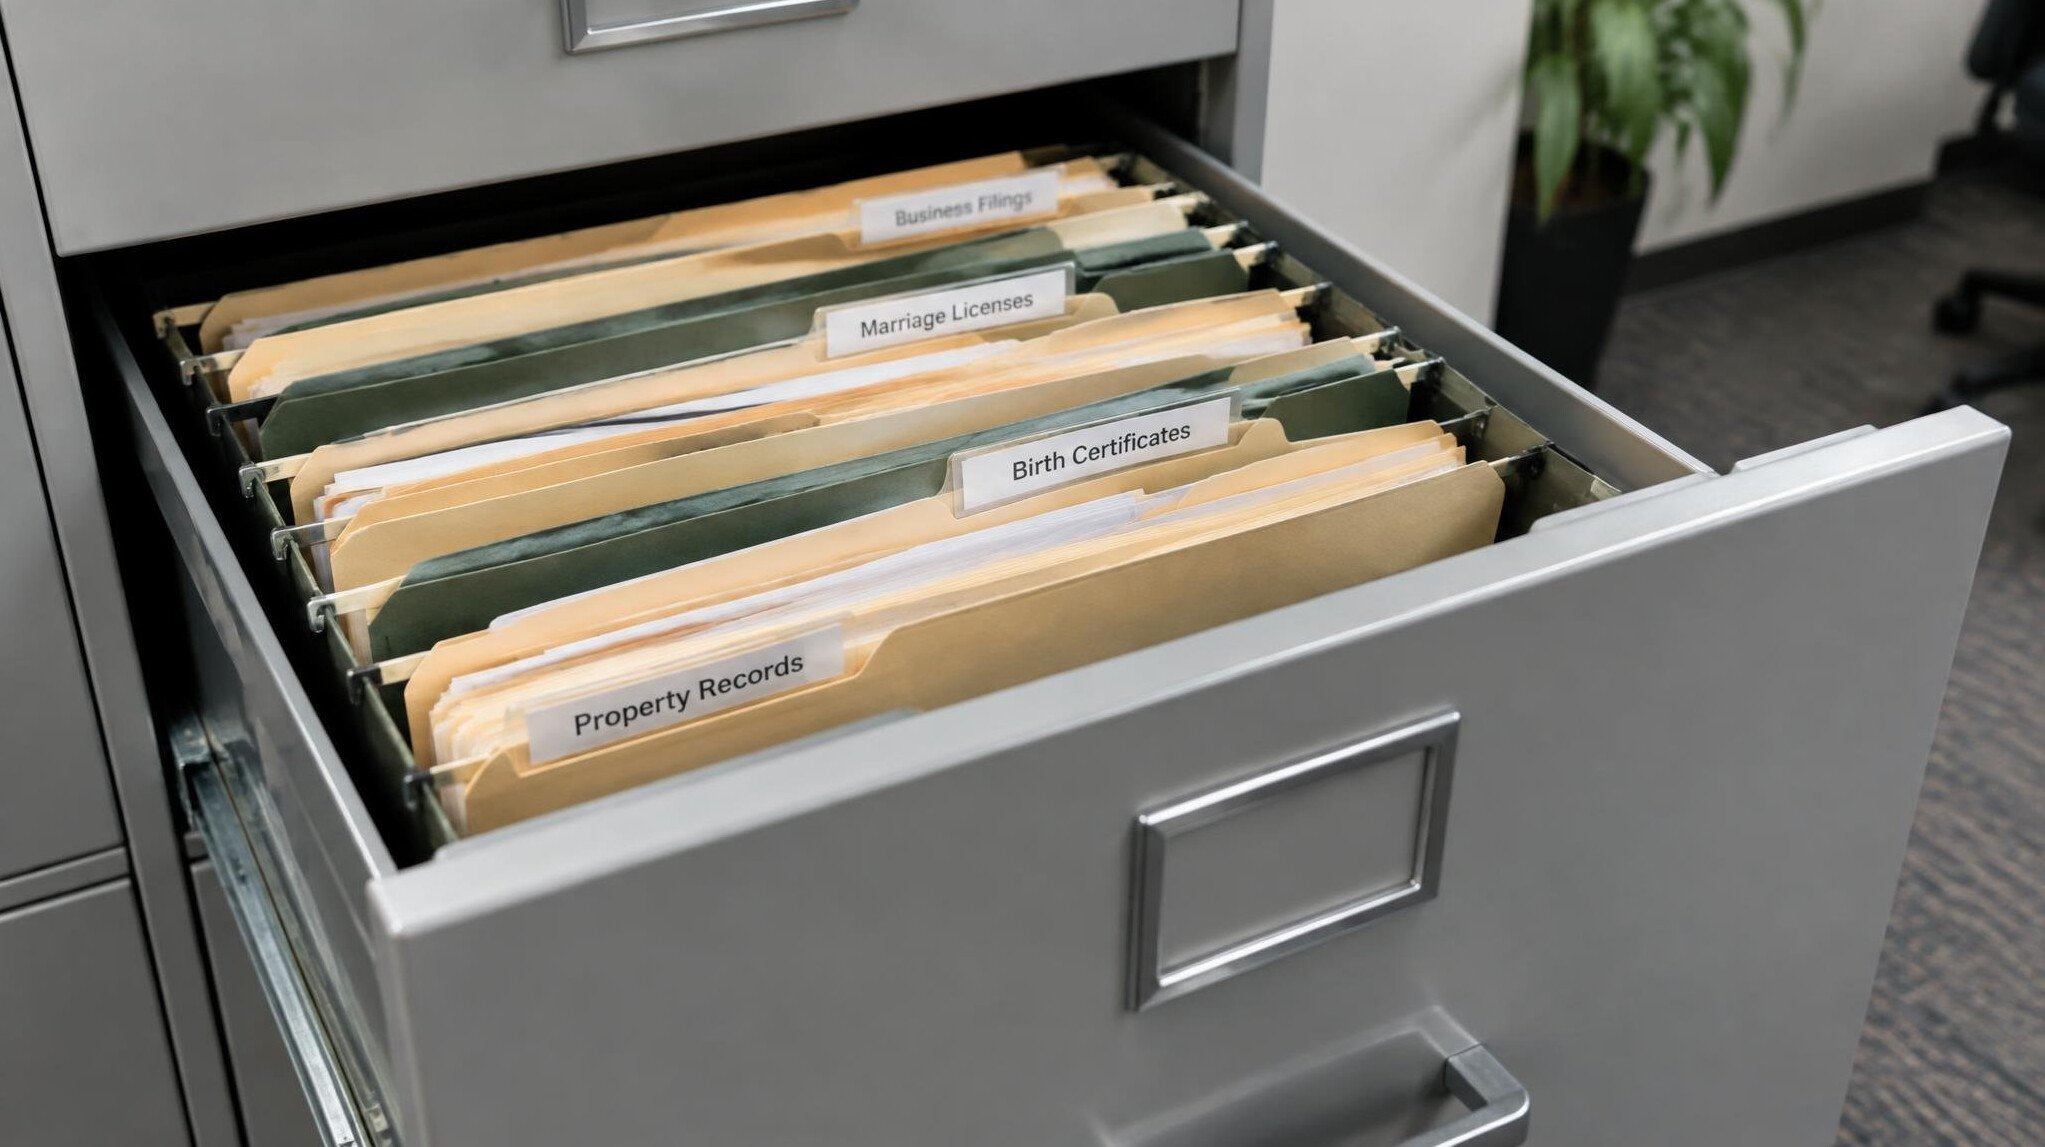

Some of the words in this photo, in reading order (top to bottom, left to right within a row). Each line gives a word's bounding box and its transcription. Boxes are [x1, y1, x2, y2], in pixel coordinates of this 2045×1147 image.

[895, 202, 973, 227] Business
[977, 191, 1033, 213] Filings
[860, 311, 946, 338] Marriage
[952, 293, 1034, 322] Licenses
[1012, 452, 1065, 481] Birth
[1073, 425, 1191, 464] Certificates
[574, 690, 691, 735] Property
[699, 656, 804, 700] Records
